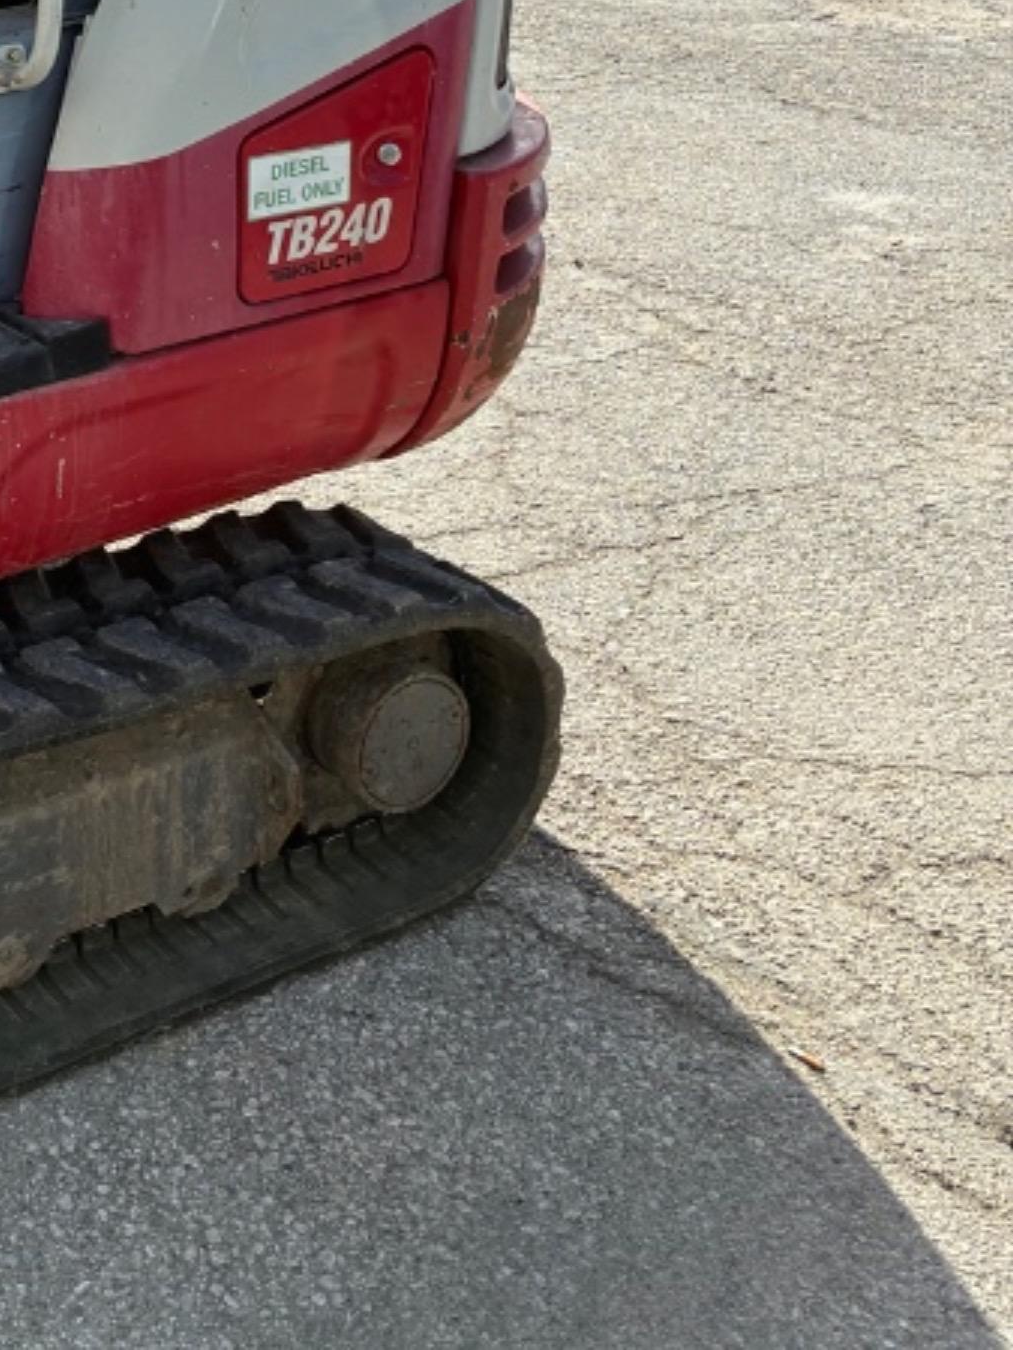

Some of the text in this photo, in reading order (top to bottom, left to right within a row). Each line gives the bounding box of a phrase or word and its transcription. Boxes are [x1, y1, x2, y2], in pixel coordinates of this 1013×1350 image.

[271, 156, 330, 181] DIESEL
[253, 177, 345, 211] FUEL ONLY
[267, 197, 393, 265] TB240
